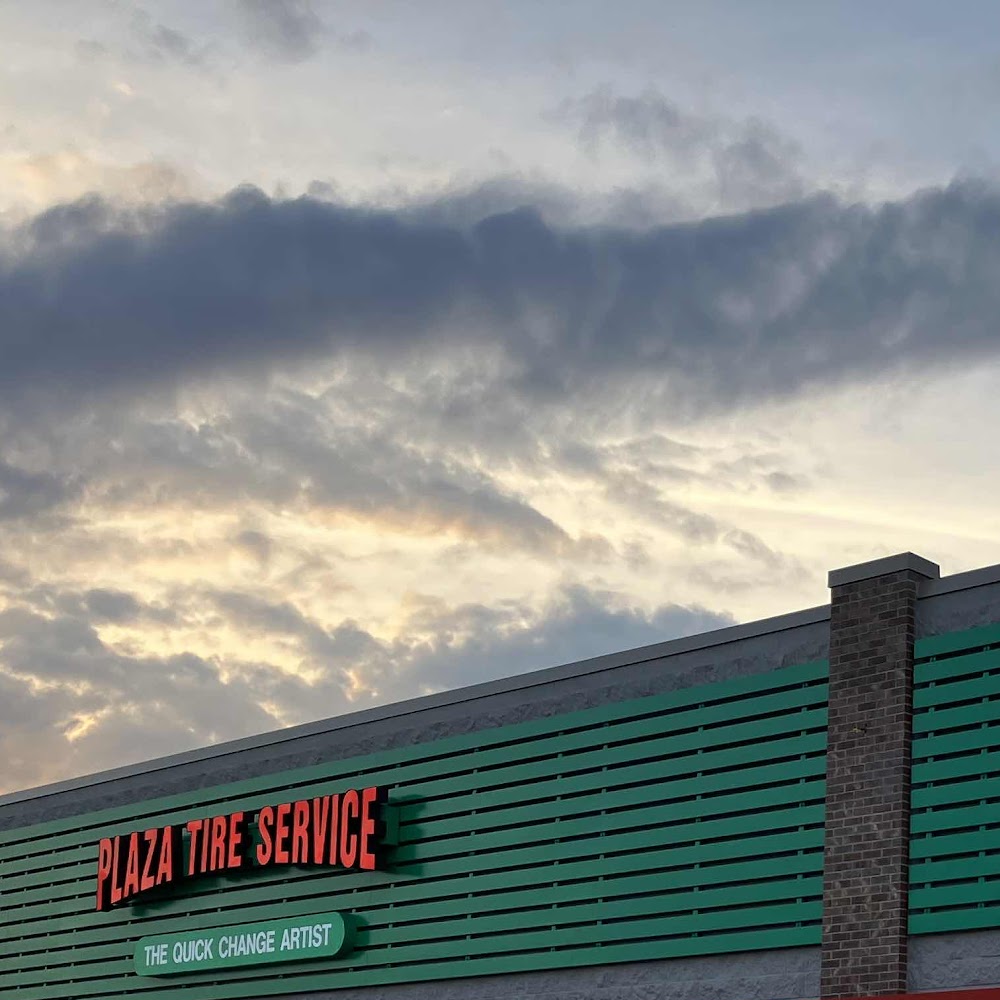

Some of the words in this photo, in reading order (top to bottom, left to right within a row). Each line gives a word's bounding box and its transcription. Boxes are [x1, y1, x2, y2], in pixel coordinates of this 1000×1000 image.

[96, 825, 172, 911] PLAZA
[187, 811, 244, 875] TIRE
[256, 786, 377, 870] SERVICE
[144, 944, 168, 966] THE
[172, 938, 214, 963] QUICK
[218, 931, 276, 958] CHANGE
[280, 924, 332, 951] ARTIST
